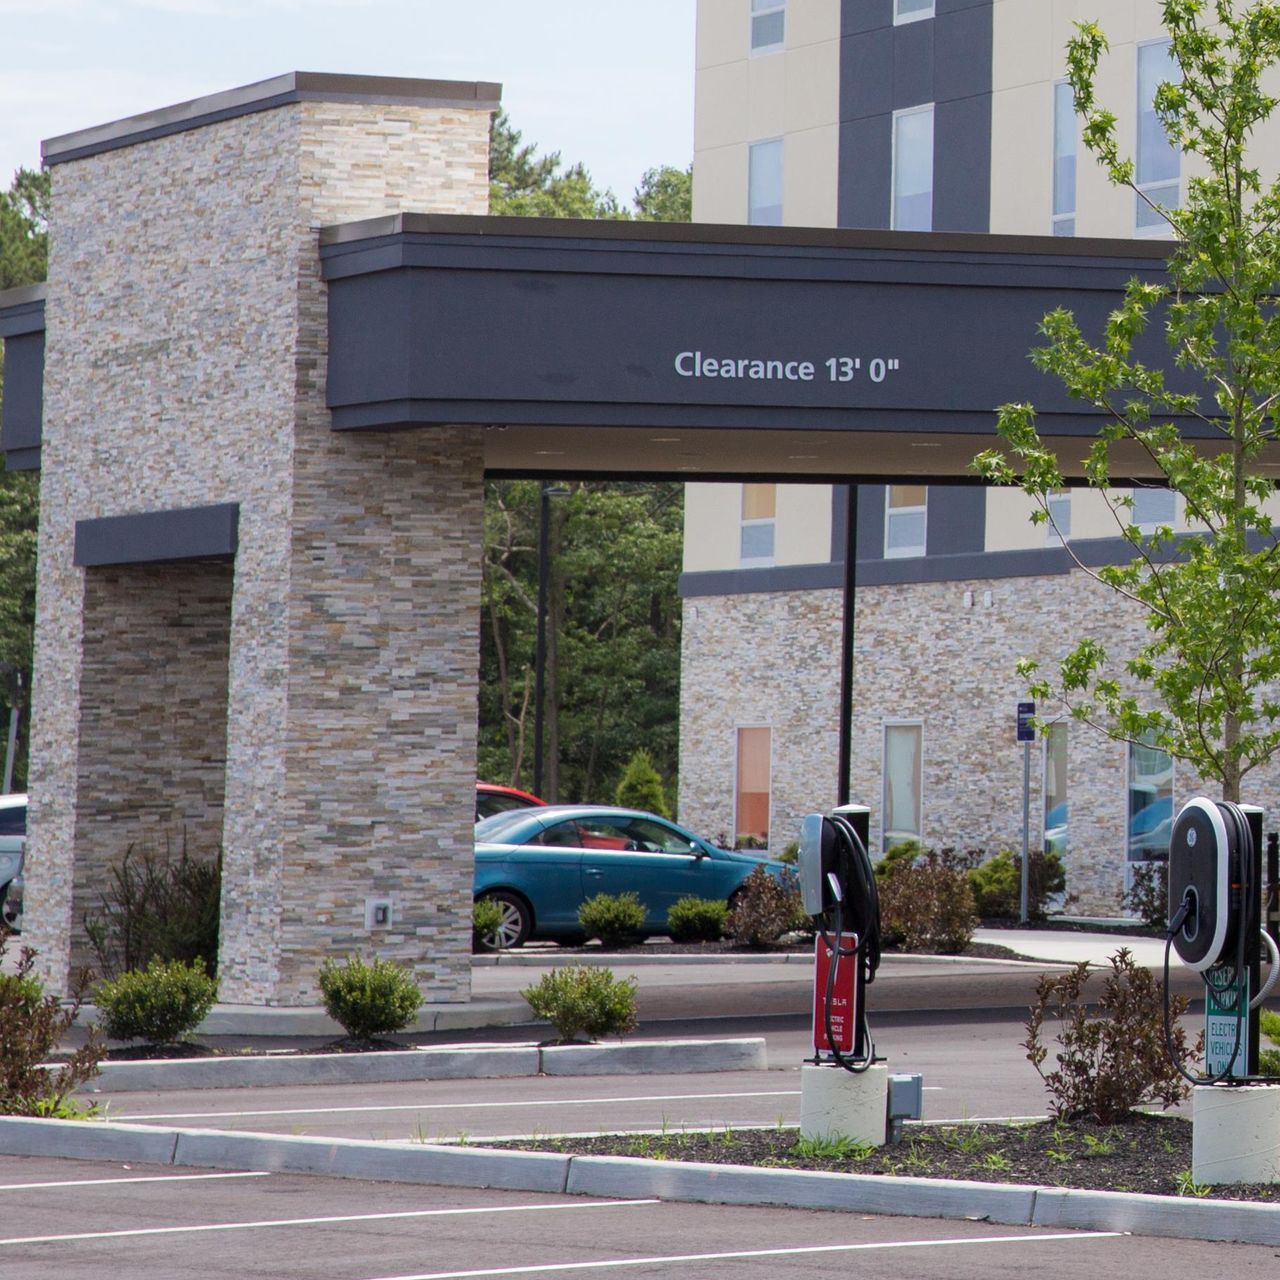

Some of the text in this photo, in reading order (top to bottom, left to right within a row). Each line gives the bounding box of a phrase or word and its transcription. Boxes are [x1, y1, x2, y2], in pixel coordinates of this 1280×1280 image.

[674, 351, 900, 383] Clearance 13' 0"
[1209, 966, 1246, 986] ESER
[823, 997, 847, 1007] TSLA
[1211, 1022, 1236, 1037] ELECTR
[1210, 1041, 1243, 1057] VEHICLS
